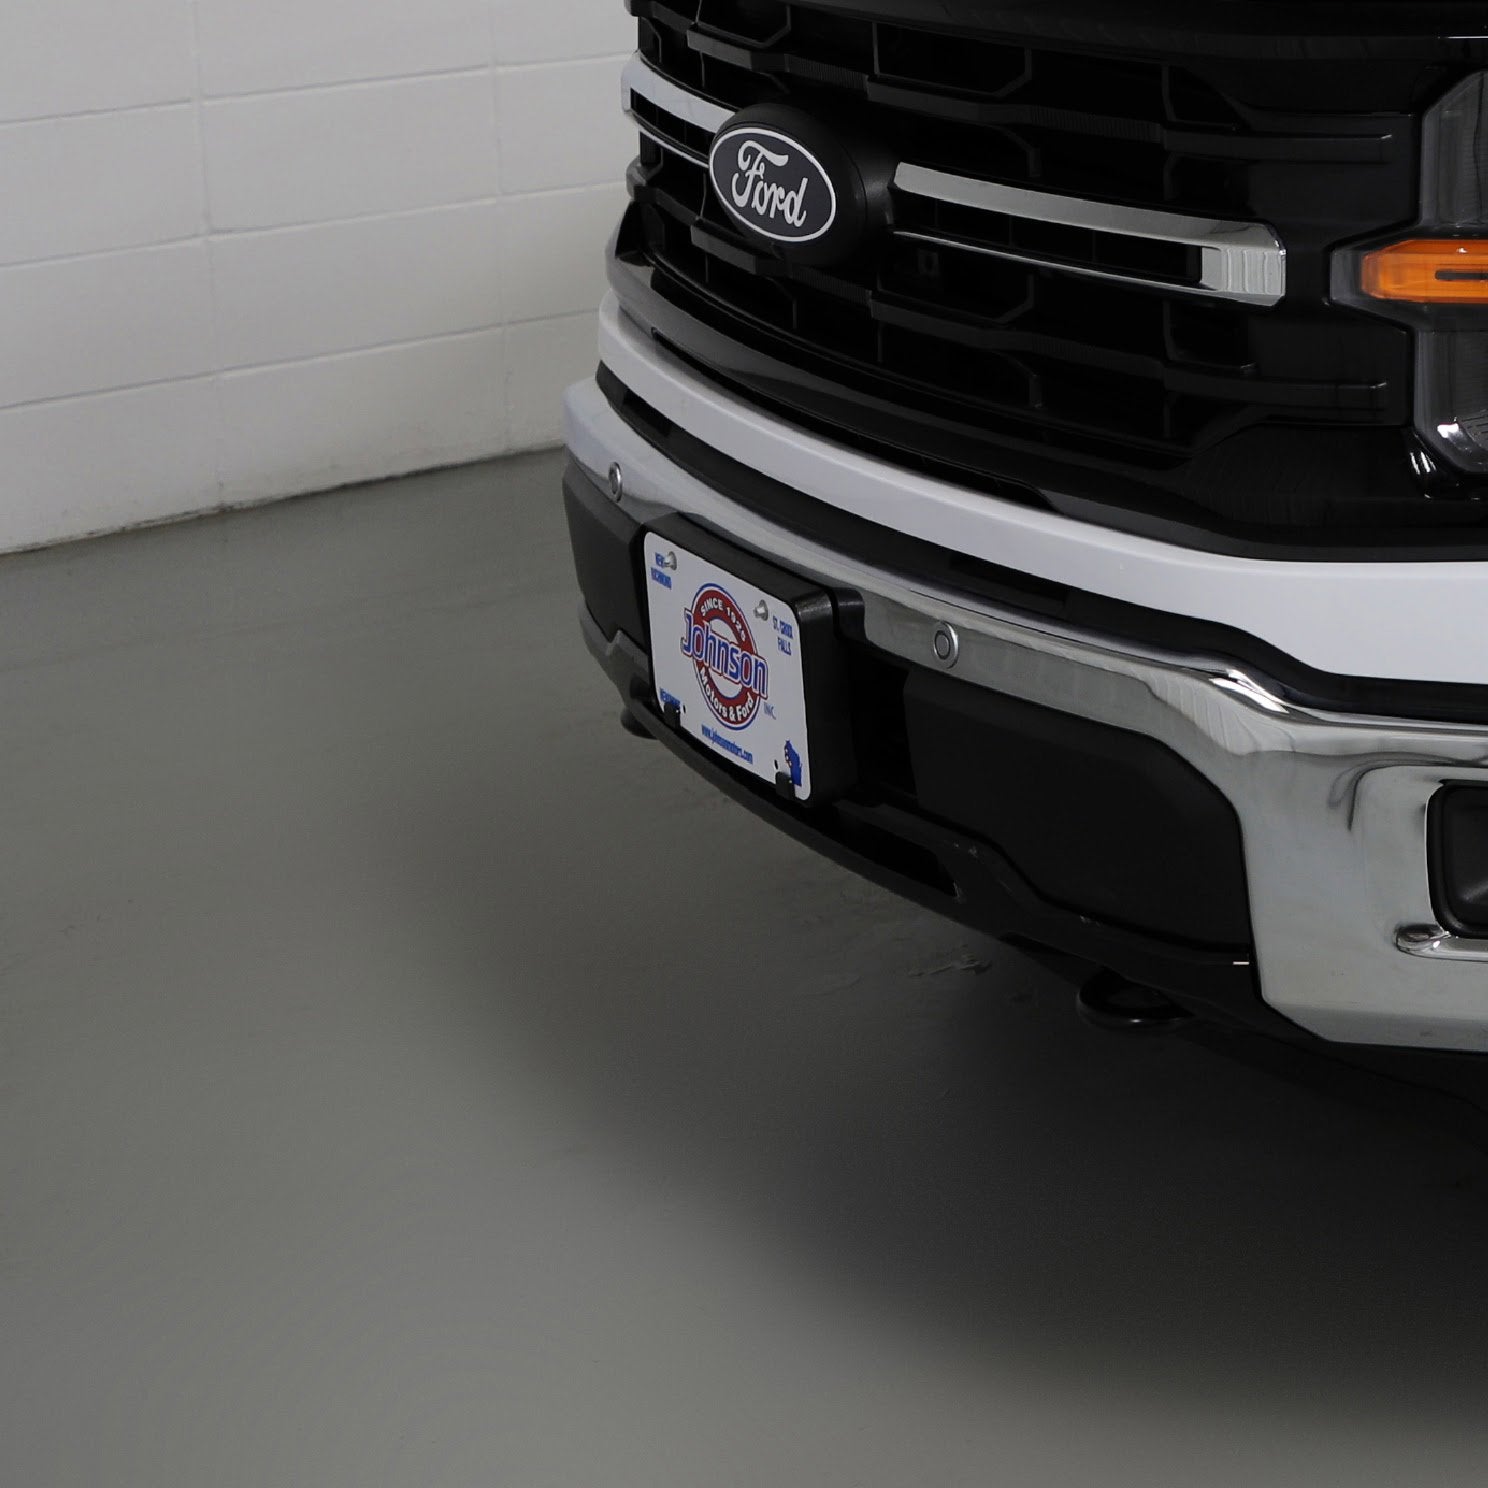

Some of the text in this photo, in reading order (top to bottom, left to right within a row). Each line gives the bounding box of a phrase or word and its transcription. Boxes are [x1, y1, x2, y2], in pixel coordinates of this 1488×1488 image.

[732, 140, 808, 227] Ford
[701, 598, 723, 616] SINCE
[682, 608, 768, 700] Johnson
[700, 666, 727, 718] Motors
[728, 705, 737, 722] &
[736, 691, 754, 722] Ford
